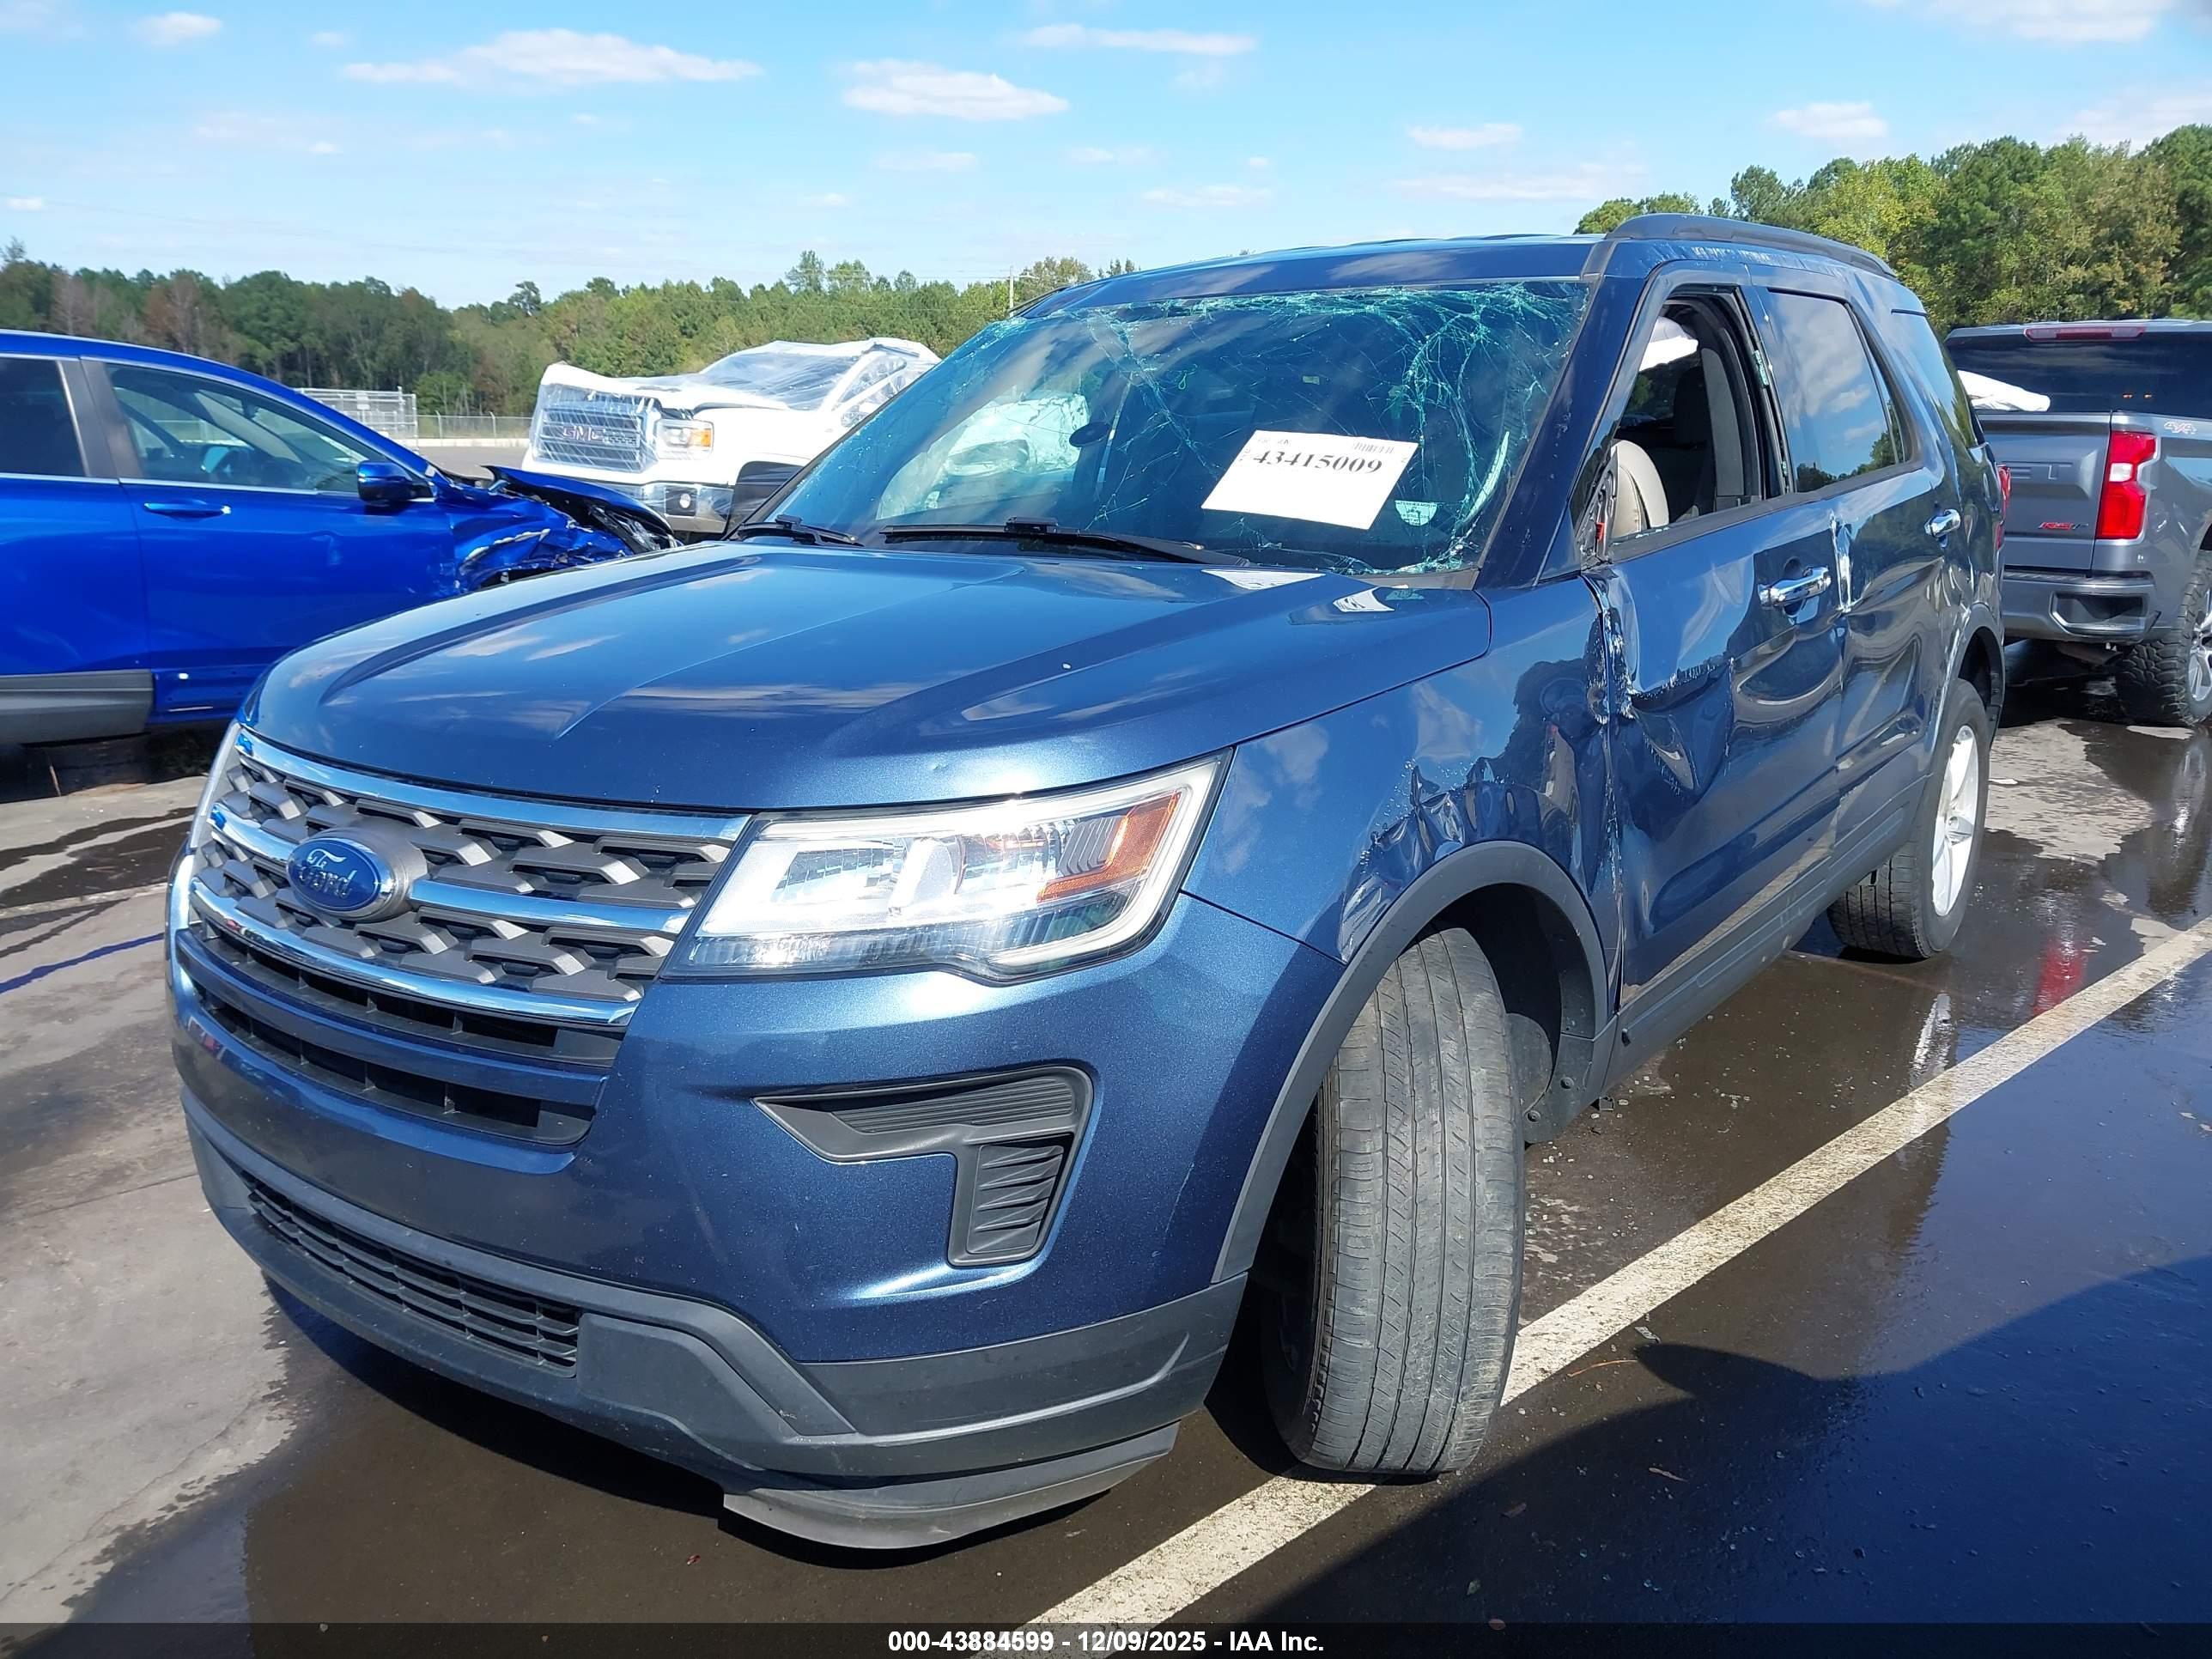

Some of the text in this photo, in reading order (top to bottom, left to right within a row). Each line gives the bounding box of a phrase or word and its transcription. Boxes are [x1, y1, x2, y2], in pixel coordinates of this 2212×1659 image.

[563, 425, 605, 441] GMC
[1253, 450, 1382, 473] 43415009
[297, 848, 358, 898] Ford
